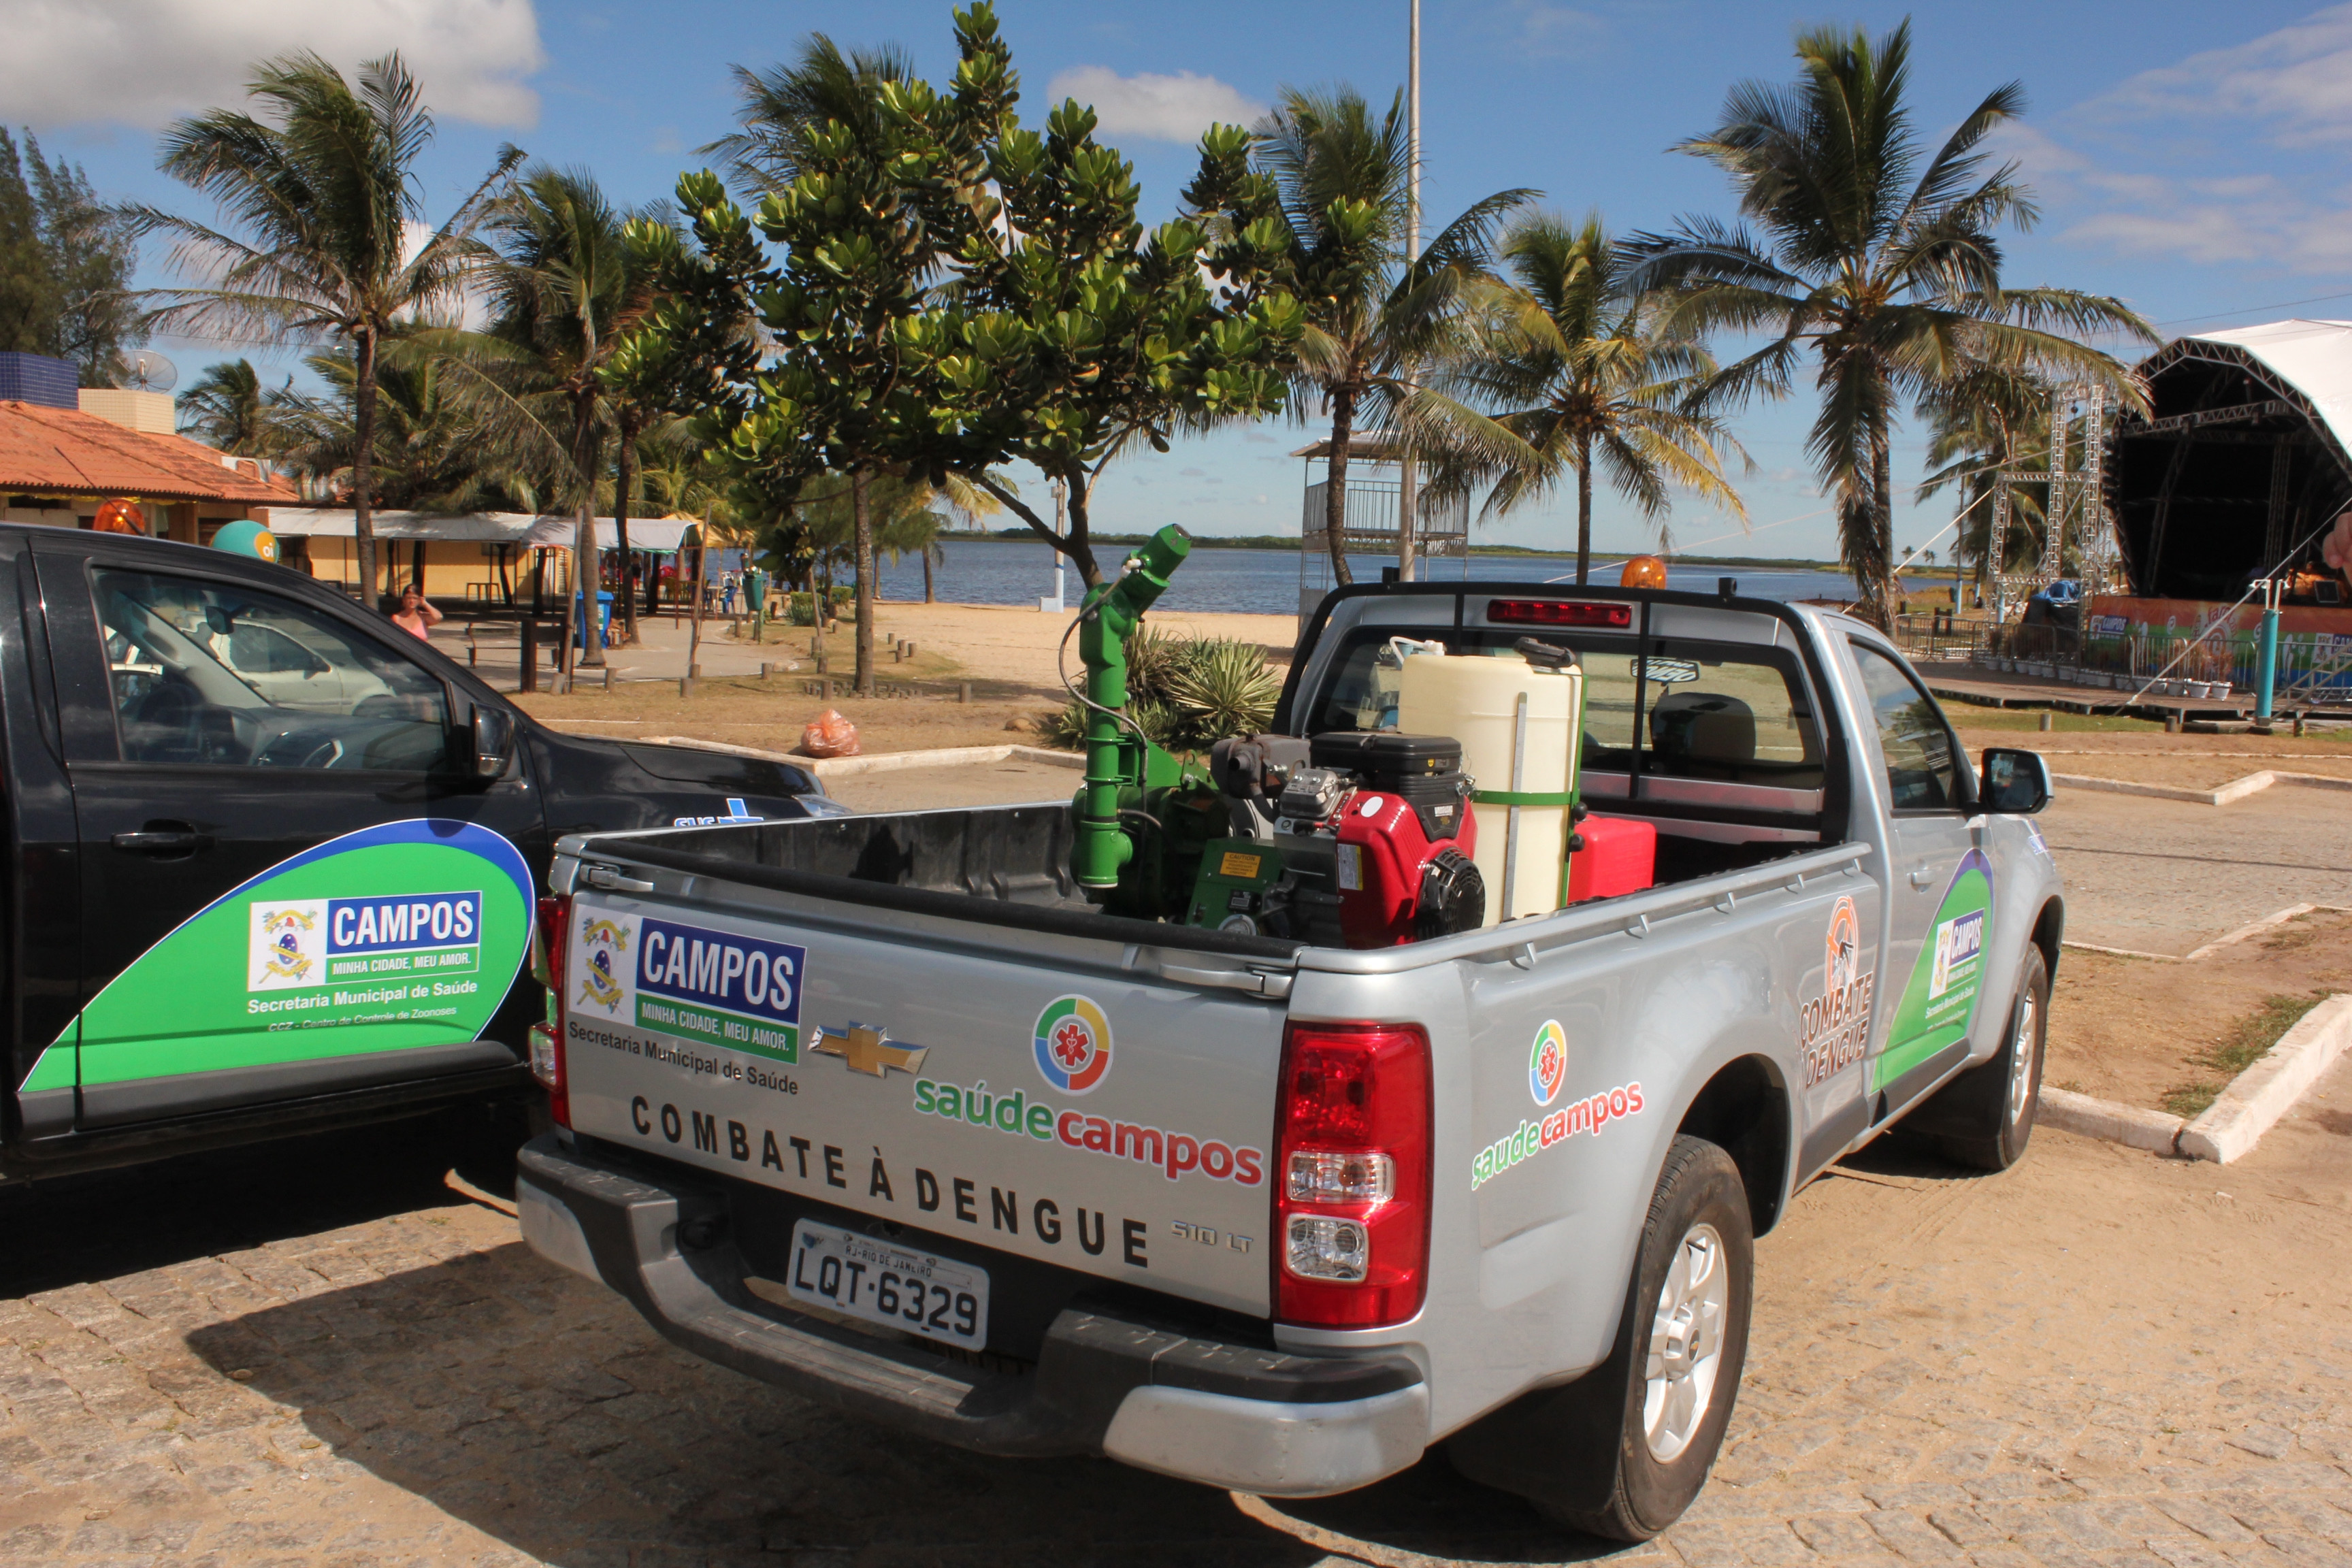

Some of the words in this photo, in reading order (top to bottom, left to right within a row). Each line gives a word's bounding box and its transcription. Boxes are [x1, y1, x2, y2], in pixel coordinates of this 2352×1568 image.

[263, 542, 274, 557] oi
[2102, 617, 2127, 632] CAMPOS
[1229, 853, 1256, 862] CAUTION
[333, 900, 474, 947] CAMPOS
[1951, 917, 1982, 959] CAMPOS
[332, 960, 368, 975] MINHA
[371, 957, 412, 973] CIDADE,
[414, 955, 436, 968] MEU
[439, 953, 471, 966] AMOR.
[644, 930, 794, 1011] CAMPOS
[248, 993, 329, 1014] Secretaria
[334, 986, 407, 1004] Municipal
[412, 983, 429, 998] de
[433, 980, 478, 997] Saúde
[1801, 971, 1874, 1051] COMBATE
[269, 1022, 293, 1032] CCZ
[303, 1019, 336, 1030] Centro
[354, 1013, 395, 1025] Controle
[397, 1011, 410, 1020] de
[412, 1007, 457, 1019] Zoonoses
[642, 1002, 676, 1024] MINHA
[679, 1011, 721, 1038] CIDADE,
[725, 1021, 749, 1043] MEU
[752, 1028, 789, 1051] AMOR.
[569, 1022, 641, 1054] Secretaria
[645, 1040, 718, 1075] Municipal
[723, 1062, 742, 1081] de
[747, 1066, 799, 1095] Saúde
[1806, 1017, 1869, 1089] DENGUE
[632, 1095, 847, 1189] COMBATE
[869, 1145, 894, 1202] À
[915, 1167, 1148, 1269] DENGUE
[1171, 1220, 1217, 1245] S10
[1226, 1232, 1253, 1253] LT
[879, 1254, 892, 1266] DE
